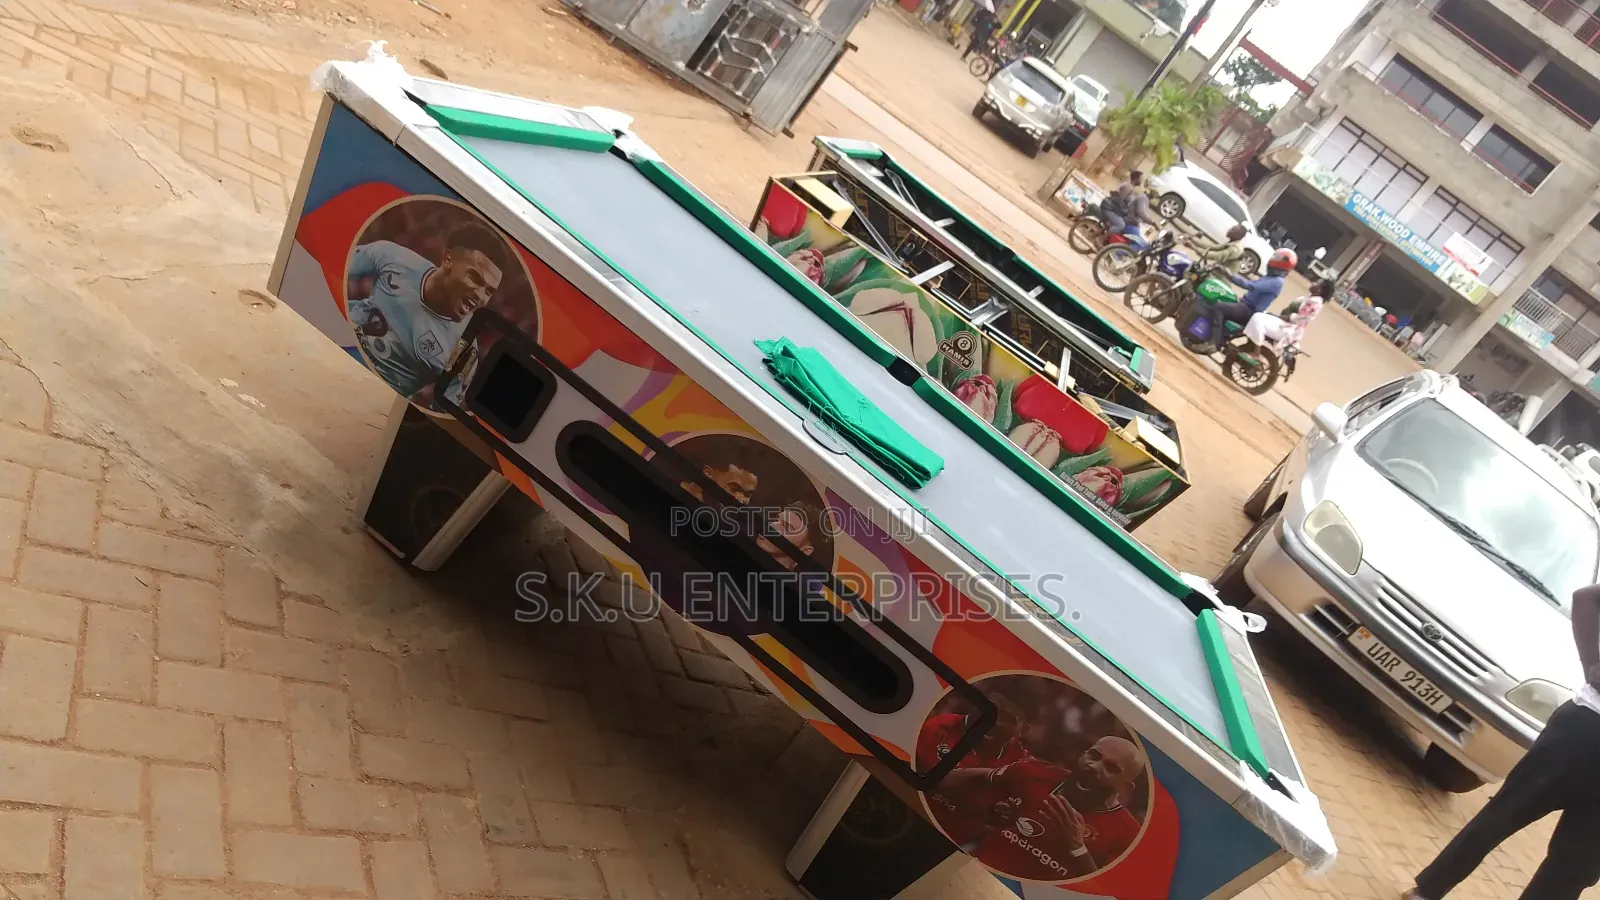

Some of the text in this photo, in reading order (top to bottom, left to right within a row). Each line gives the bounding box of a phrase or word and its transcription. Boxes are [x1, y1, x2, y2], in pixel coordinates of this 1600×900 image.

[1409, 235, 1448, 265] EMPIRE
[942, 344, 969, 366] HAMIS
[960, 340, 969, 348] 8
[1367, 642, 1444, 706] UAR 913H
